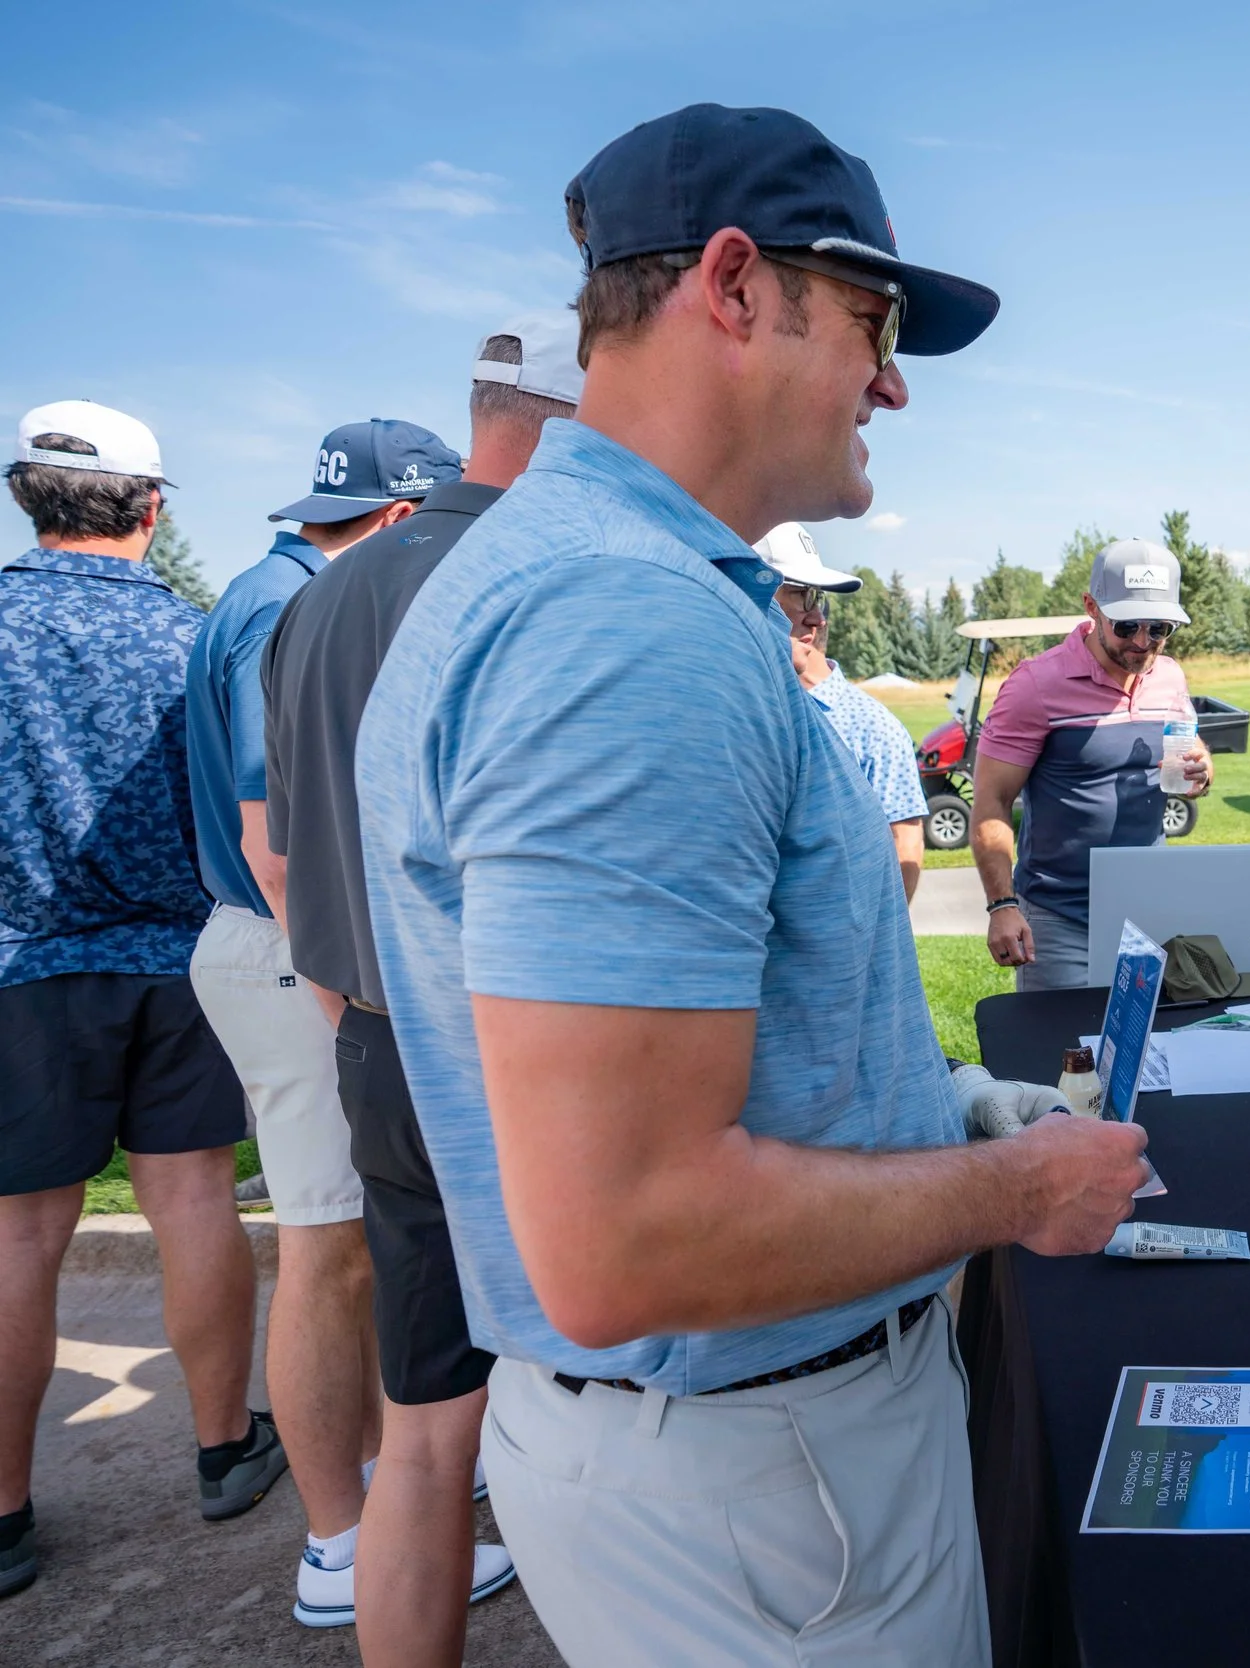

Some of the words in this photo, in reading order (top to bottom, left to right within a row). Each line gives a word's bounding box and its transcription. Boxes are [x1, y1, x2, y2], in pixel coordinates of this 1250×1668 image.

[400, 478, 434, 487] ANDREWS
[1149, 1388, 1166, 1420] venmo
[1147, 1450, 1159, 1464] TO
[1160, 1450, 1176, 1483] THANK
[1120, 1450, 1143, 1505] SPONSORS!
[1142, 1466, 1157, 1487] OUR
[1174, 1460, 1190, 1502] SINCERE
[1155, 1486, 1170, 1506] YOU
